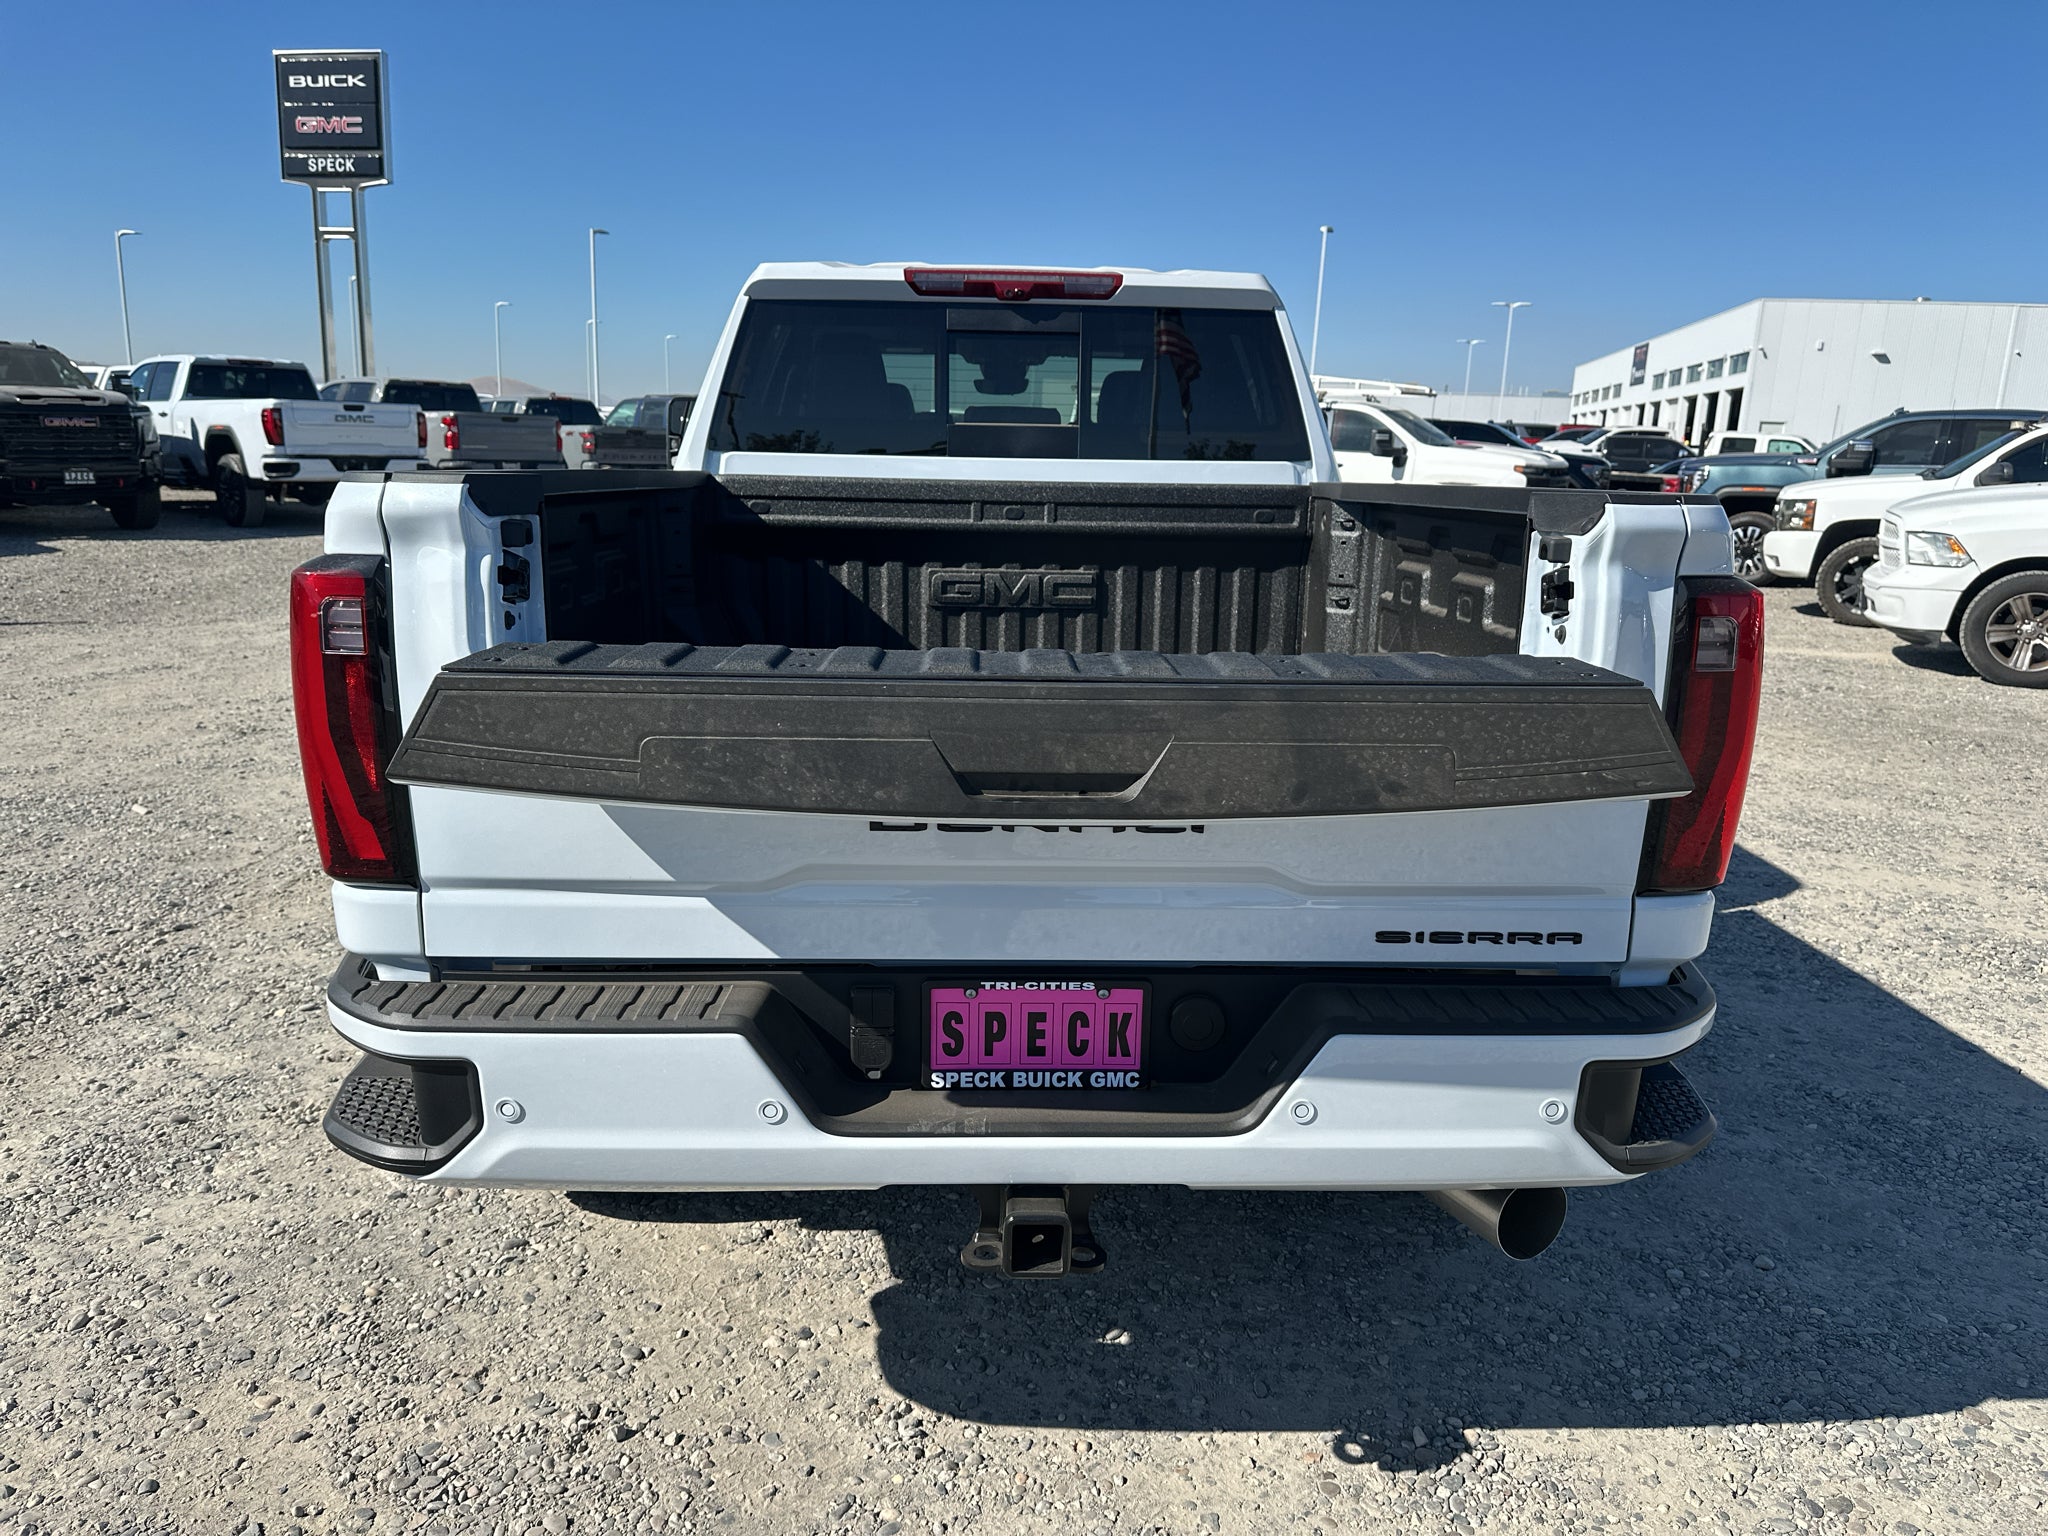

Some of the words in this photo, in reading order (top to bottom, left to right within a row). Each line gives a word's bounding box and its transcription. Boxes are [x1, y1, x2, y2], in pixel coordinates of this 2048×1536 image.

[288, 74, 367, 88] BUICK
[295, 116, 363, 134] GMC
[308, 158, 355, 172] SPECK
[44, 417, 97, 427] GMC
[335, 414, 375, 424] GMC
[931, 572, 1095, 605] GMC
[1375, 930, 1583, 945] SIERRA
[980, 981, 1096, 991] TRI-CITIES
[941, 1010, 1133, 1057] SPECK
[930, 1072, 1006, 1088] SPECK
[1012, 1072, 1083, 1088] BUICK
[1089, 1072, 1140, 1088] GMC
